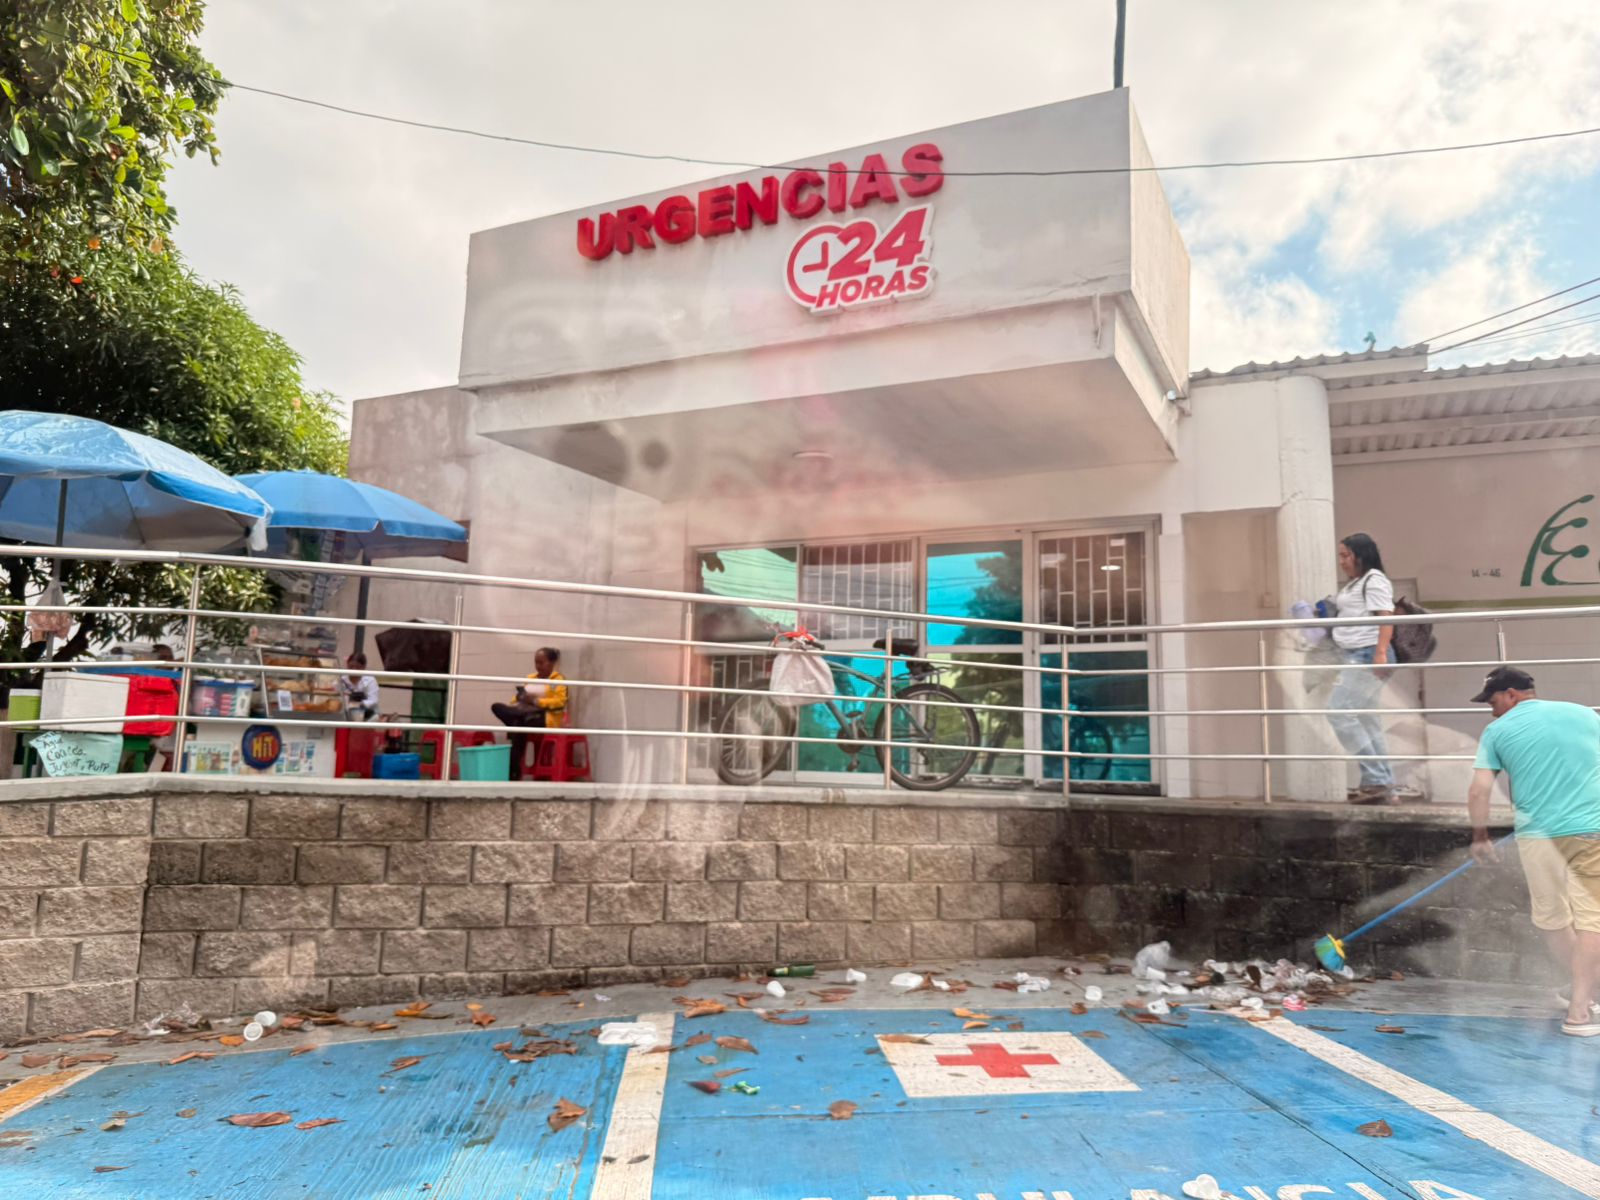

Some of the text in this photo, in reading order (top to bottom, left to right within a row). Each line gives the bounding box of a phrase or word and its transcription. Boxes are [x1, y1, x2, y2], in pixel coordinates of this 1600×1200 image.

[577, 143, 944, 261] URGENCIAS
[827, 207, 927, 281] 24
[815, 264, 930, 309] HORAS
